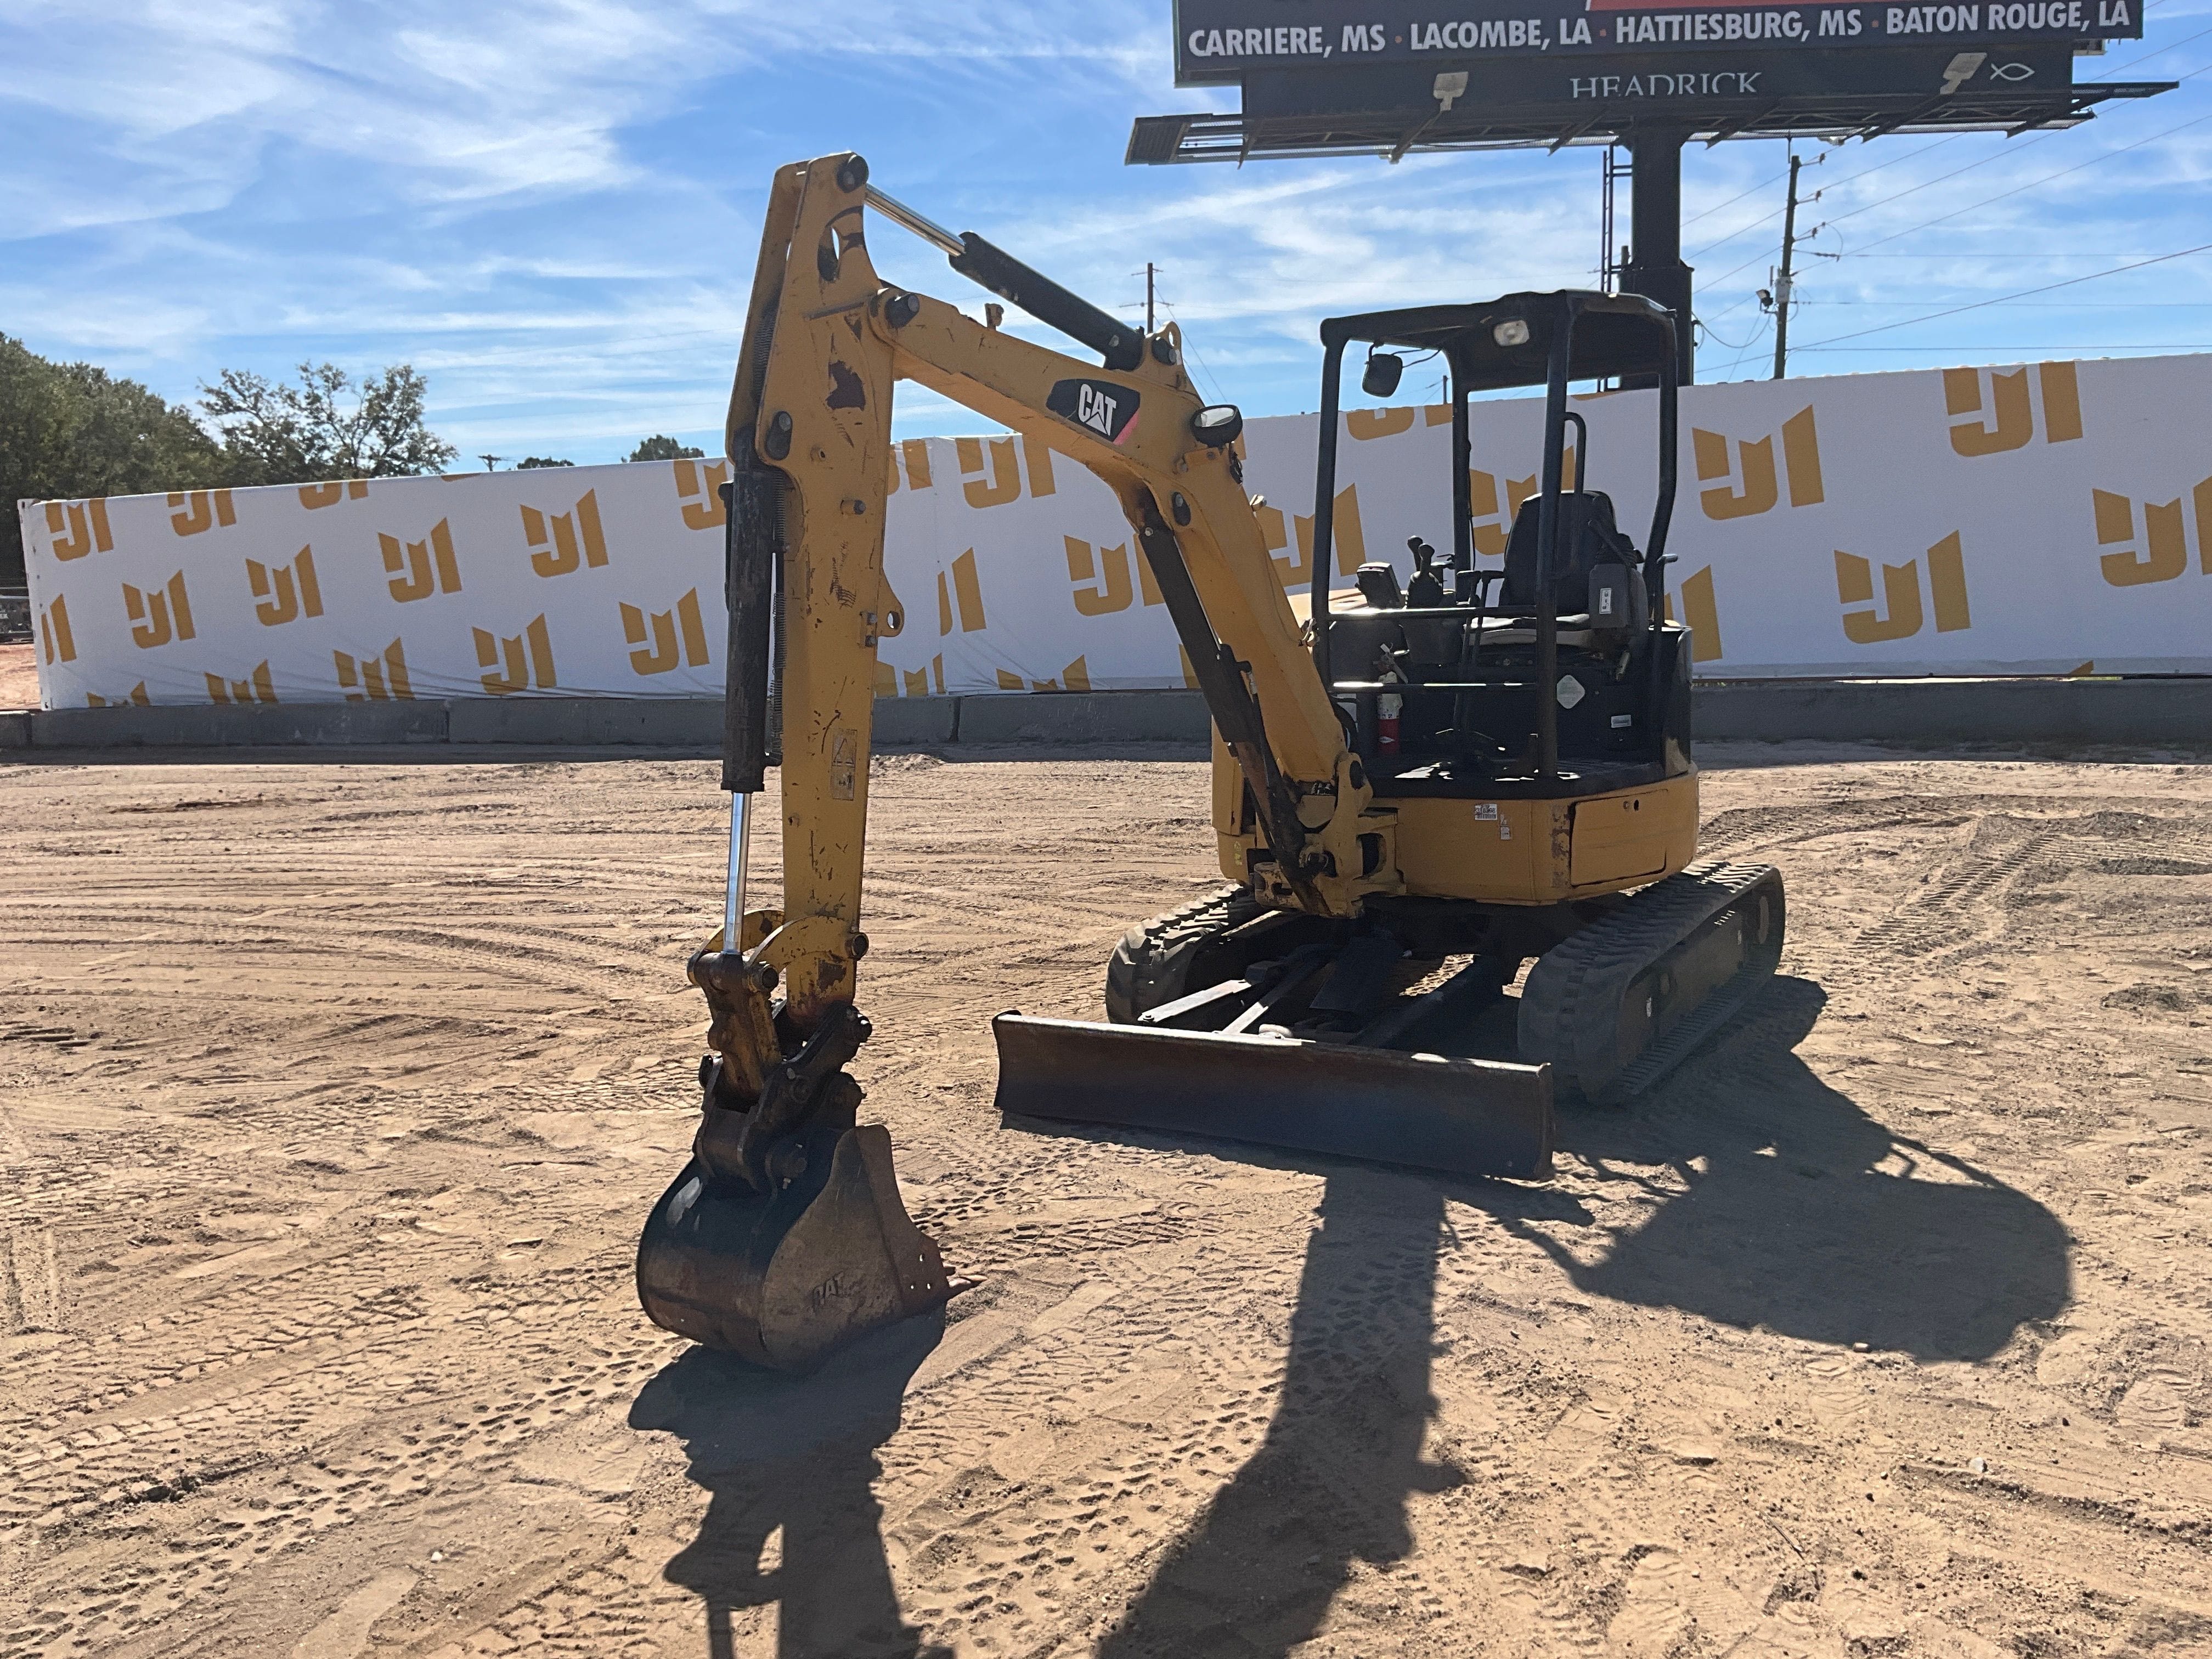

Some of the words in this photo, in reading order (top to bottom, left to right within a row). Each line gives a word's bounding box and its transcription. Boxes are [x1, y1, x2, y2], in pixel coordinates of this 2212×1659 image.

[1188, 26, 1333, 58] CARRIERE,
[1341, 24, 1386, 52] MS
[1410, 19, 1550, 50] LACOMBE,
[1560, 18, 1592, 44] LA
[1617, 11, 1810, 43] HATTIESBURG,
[1819, 9, 1862, 36] MS
[1887, 4, 1979, 33] BATON
[1988, 1, 2089, 31] ROUGE,
[2099, 0, 2130, 26] LA
[1569, 72, 1762, 99] HEADRICK
[1078, 383, 1117, 436] CAT
